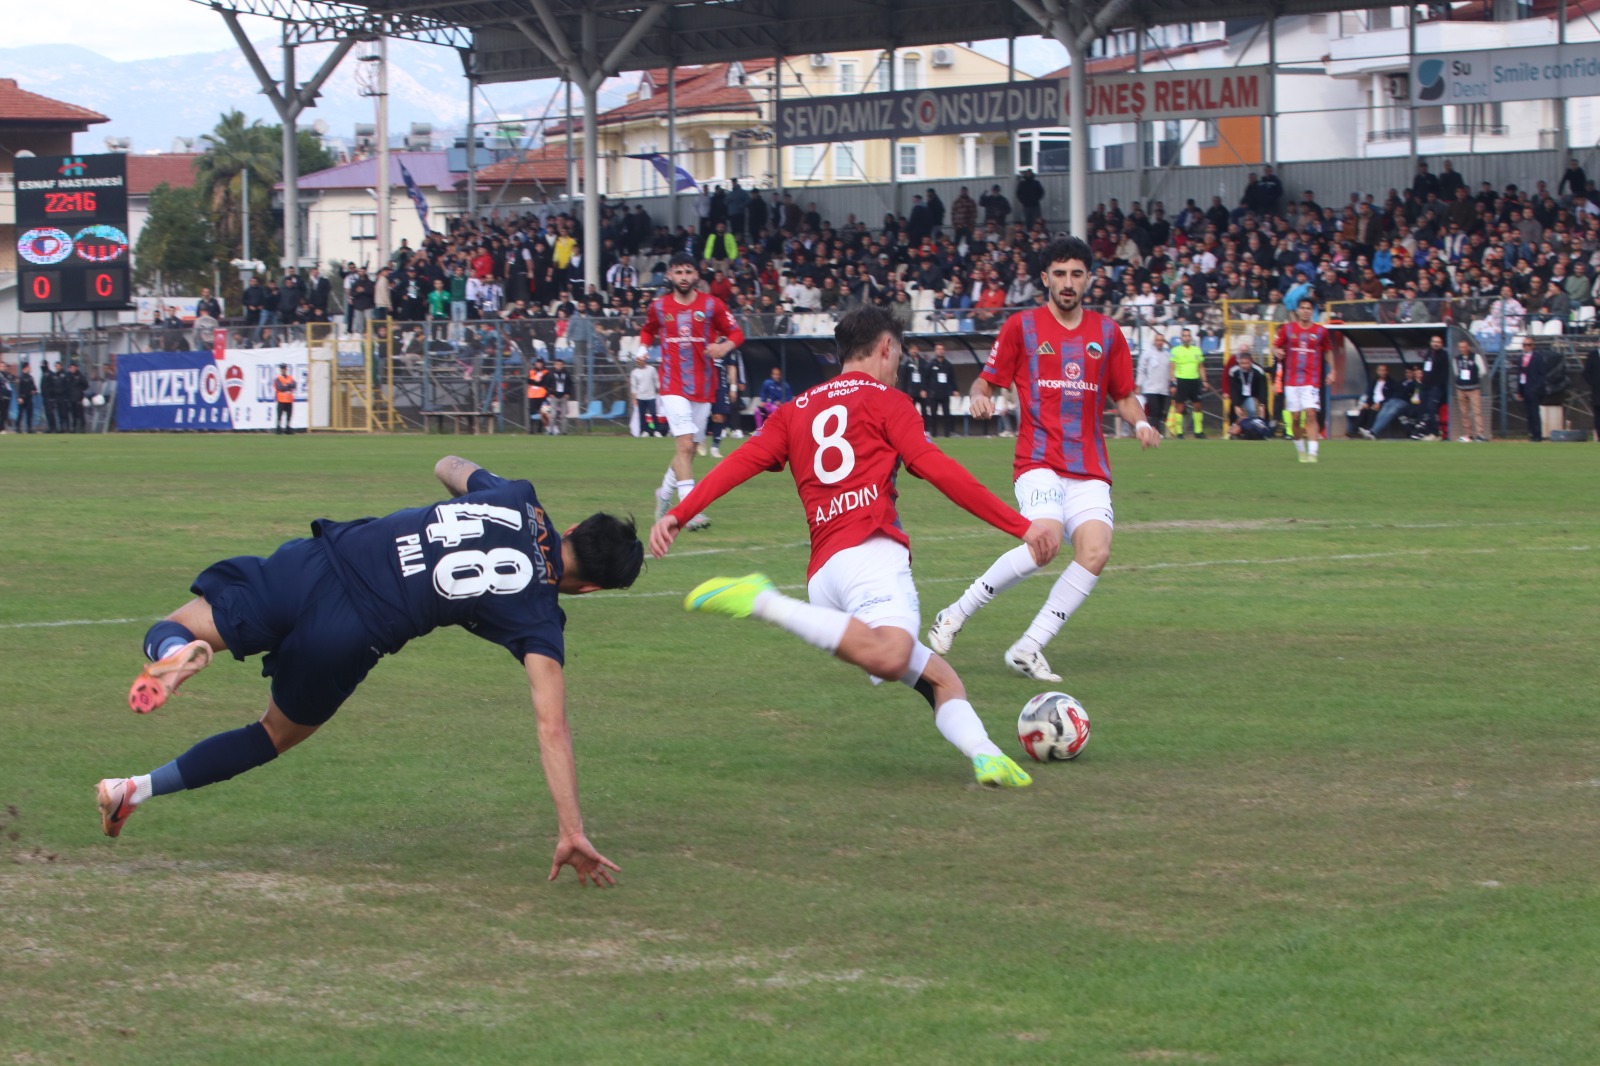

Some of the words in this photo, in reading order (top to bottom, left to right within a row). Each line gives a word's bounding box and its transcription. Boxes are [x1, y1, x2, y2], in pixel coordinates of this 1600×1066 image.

[1452, 61, 1471, 76] Su
[1494, 62, 1539, 83] Smile
[1064, 79, 1146, 121] ÜNEŞ
[1154, 75, 1259, 112] REKLAM
[783, 98, 895, 138] SEVDAMIZ
[18, 180, 56, 189] ESNAF
[58, 176, 123, 188] HASTANESİ
[44, 192, 97, 212] 22:16
[33, 276, 50, 299] 0
[828, 386, 859, 399] GROUP
[812, 404, 855, 484] 8
[816, 484, 878, 525] A.AYDIN
[396, 534, 426, 577] PALA
[426, 503, 533, 600] 48
